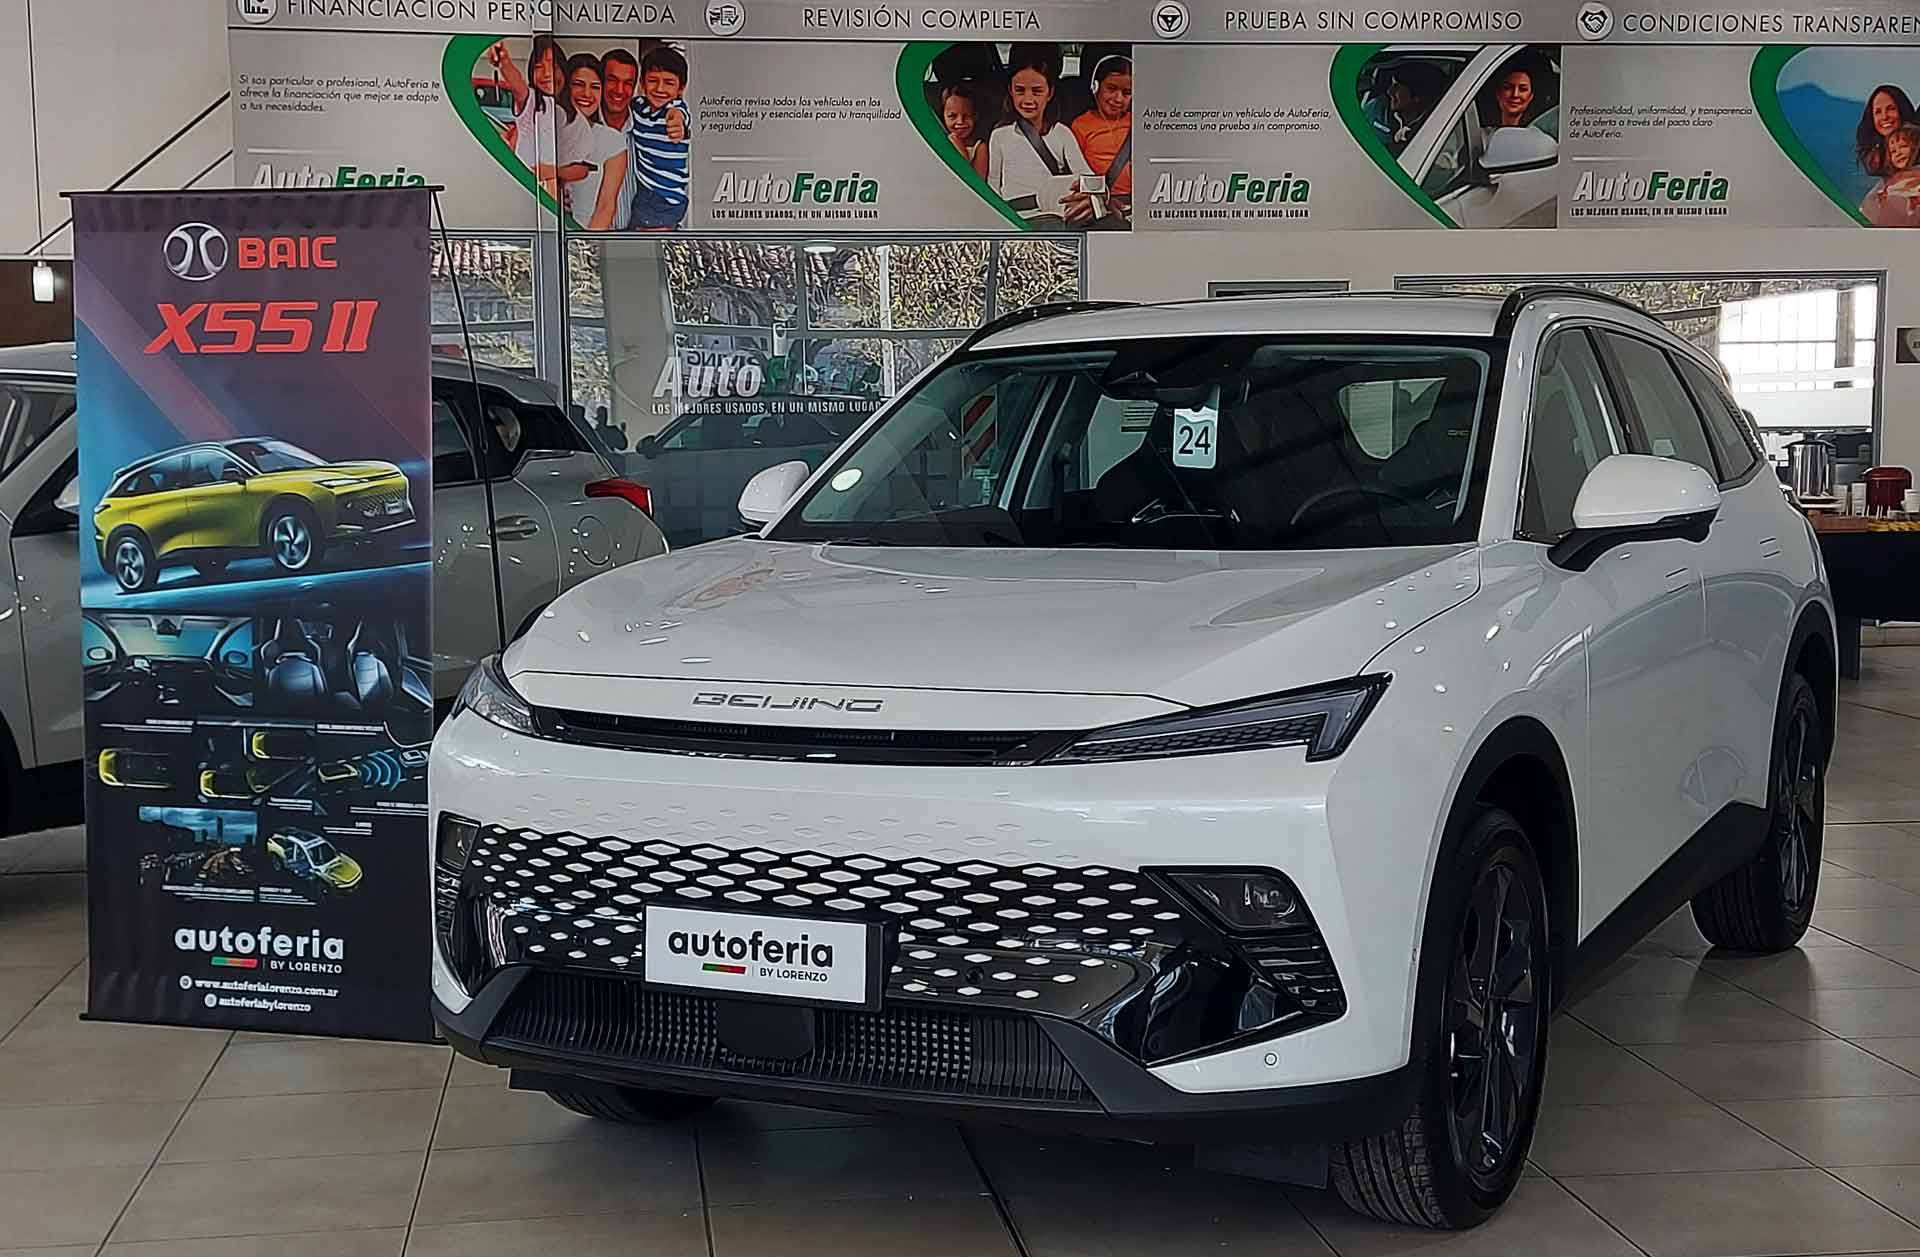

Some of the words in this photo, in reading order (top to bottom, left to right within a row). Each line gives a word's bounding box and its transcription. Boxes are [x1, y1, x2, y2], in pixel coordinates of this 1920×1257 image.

[803, 4, 911, 29] REVISIÓN
[920, 9, 1041, 31] COMPLETA
[1224, 11, 1306, 31] PRUEBA
[1317, 11, 1354, 31] SIN
[1363, 11, 1523, 31] COMPROMISO
[1623, 15, 1783, 33] CONDICIONES
[240, 74, 248, 84] Si
[269, 76, 313, 88] particular
[384, 79, 428, 88] AutoFeria
[432, 81, 439, 89] te
[240, 88, 269, 98] ofrece
[272, 88, 281, 98] la
[284, 88, 340, 100] financiación
[344, 92, 361, 104] que
[364, 92, 390, 103] mejor
[700, 96, 742, 105] AutoFeria
[774, 98, 796, 106] todos
[799, 97, 811, 106] los
[869, 98, 880, 107] los
[250, 102, 263, 111] tus
[266, 102, 325, 112] necesidades.
[1143, 109, 1166, 118] Antes
[1170, 109, 1181, 118] de
[1184, 110, 1219, 120] comprar
[1236, 109, 1271, 118] vehículo
[1274, 109, 1285, 118] de
[1287, 109, 1331, 119] AutoFeria,
[700, 110, 728, 120] puntos
[732, 109, 758, 118] vitales
[761, 112, 766, 120] y
[769, 110, 812, 118] esenciales
[816, 112, 836, 121] para
[850, 110, 901, 121] tranquilidad
[701, 123, 706, 131] y
[709, 121, 752, 132] seguridad
[1143, 121, 1151, 130] te
[1154, 122, 1197, 130] ofrecemos
[1219, 122, 1249, 132] prueba
[1252, 122, 1264, 130] sin
[1267, 123, 1321, 133] compromiso.
[1570, 118, 1580, 127] de
[1583, 118, 1590, 127] la
[1593, 118, 1616, 127] oferta
[1653, 118, 1665, 127] del
[1667, 119, 1690, 128] pacto
[1692, 118, 1712, 126] claro
[1570, 130, 1580, 138] de
[253, 162, 426, 188] AutoFeria
[712, 170, 879, 204] AutoFeria
[1149, 171, 1310, 204] AutoFeria
[1572, 170, 1729, 201] AutoFeria
[712, 210, 725, 219] LOS
[728, 210, 762, 219] MEJORES
[799, 210, 808, 219] EN
[812, 210, 822, 219] UN
[825, 210, 851, 219] MISMO
[1150, 210, 1162, 219] LOS
[1165, 210, 1197, 218] MEJORES
[1232, 210, 1241, 218] EN
[1244, 210, 1254, 218] UN
[1257, 210, 1283, 218] MISMO
[1571, 208, 1584, 216] LOS
[238, 236, 337, 270] BAIC
[143, 300, 318, 354] X55
[652, 403, 670, 414] LOS
[725, 402, 768, 414] USADOS,
[771, 402, 784, 412] EN
[789, 402, 803, 412] UN
[808, 402, 845, 412] MISMO
[1178, 425, 1211, 455] 24
[692, 692, 883, 712] BEIJING
[174, 926, 344, 959] autoferia
[668, 929, 833, 967] autoferia
[271, 960, 285, 970] BY
[289, 961, 342, 973] LORENZO
[760, 968, 773, 977] BY
[777, 970, 828, 982] LORENZO
[219, 997, 311, 1012] autoferiabylorenzo
